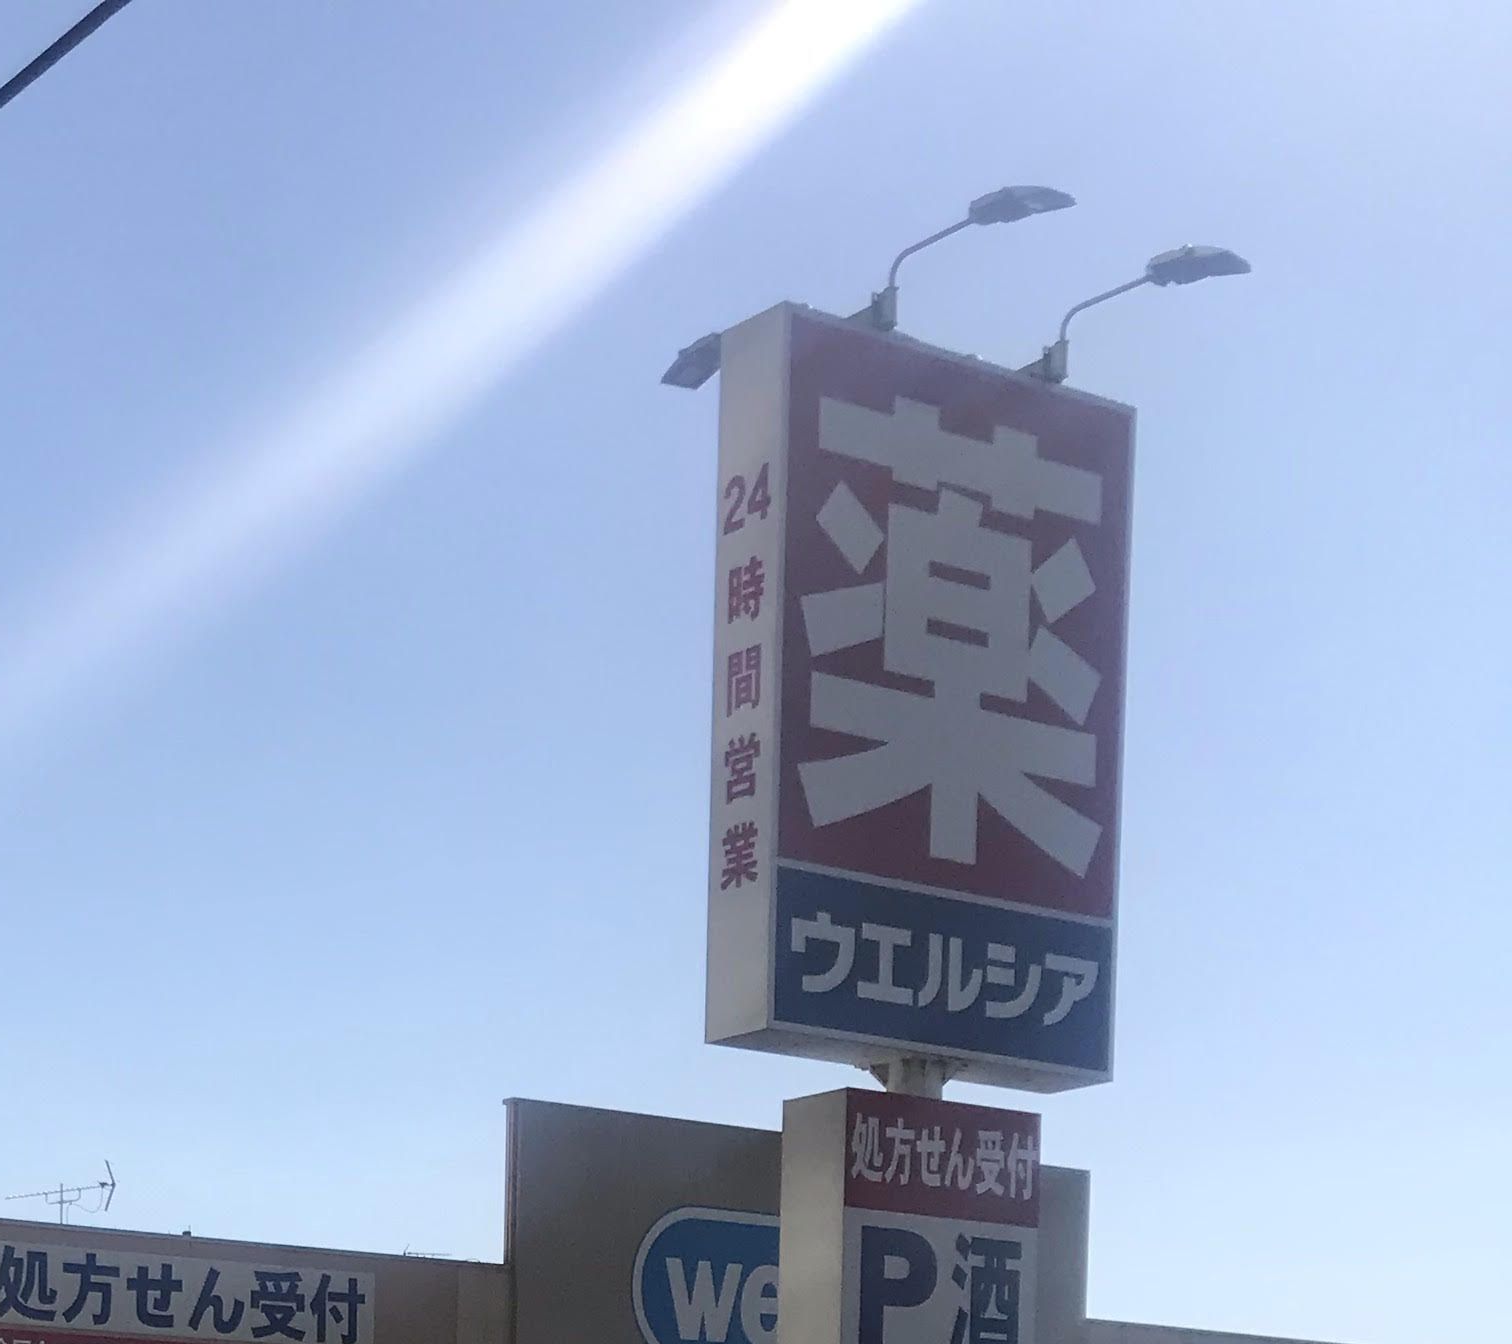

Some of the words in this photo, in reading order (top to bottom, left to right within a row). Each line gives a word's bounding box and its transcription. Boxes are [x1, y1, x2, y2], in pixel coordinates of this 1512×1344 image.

[722, 461, 771, 891] 24時間営業
[799, 396, 1103, 879] 薬
[791, 911, 1100, 1028] ウエルシア
[850, 1112, 1038, 1201] 処方せん受付
